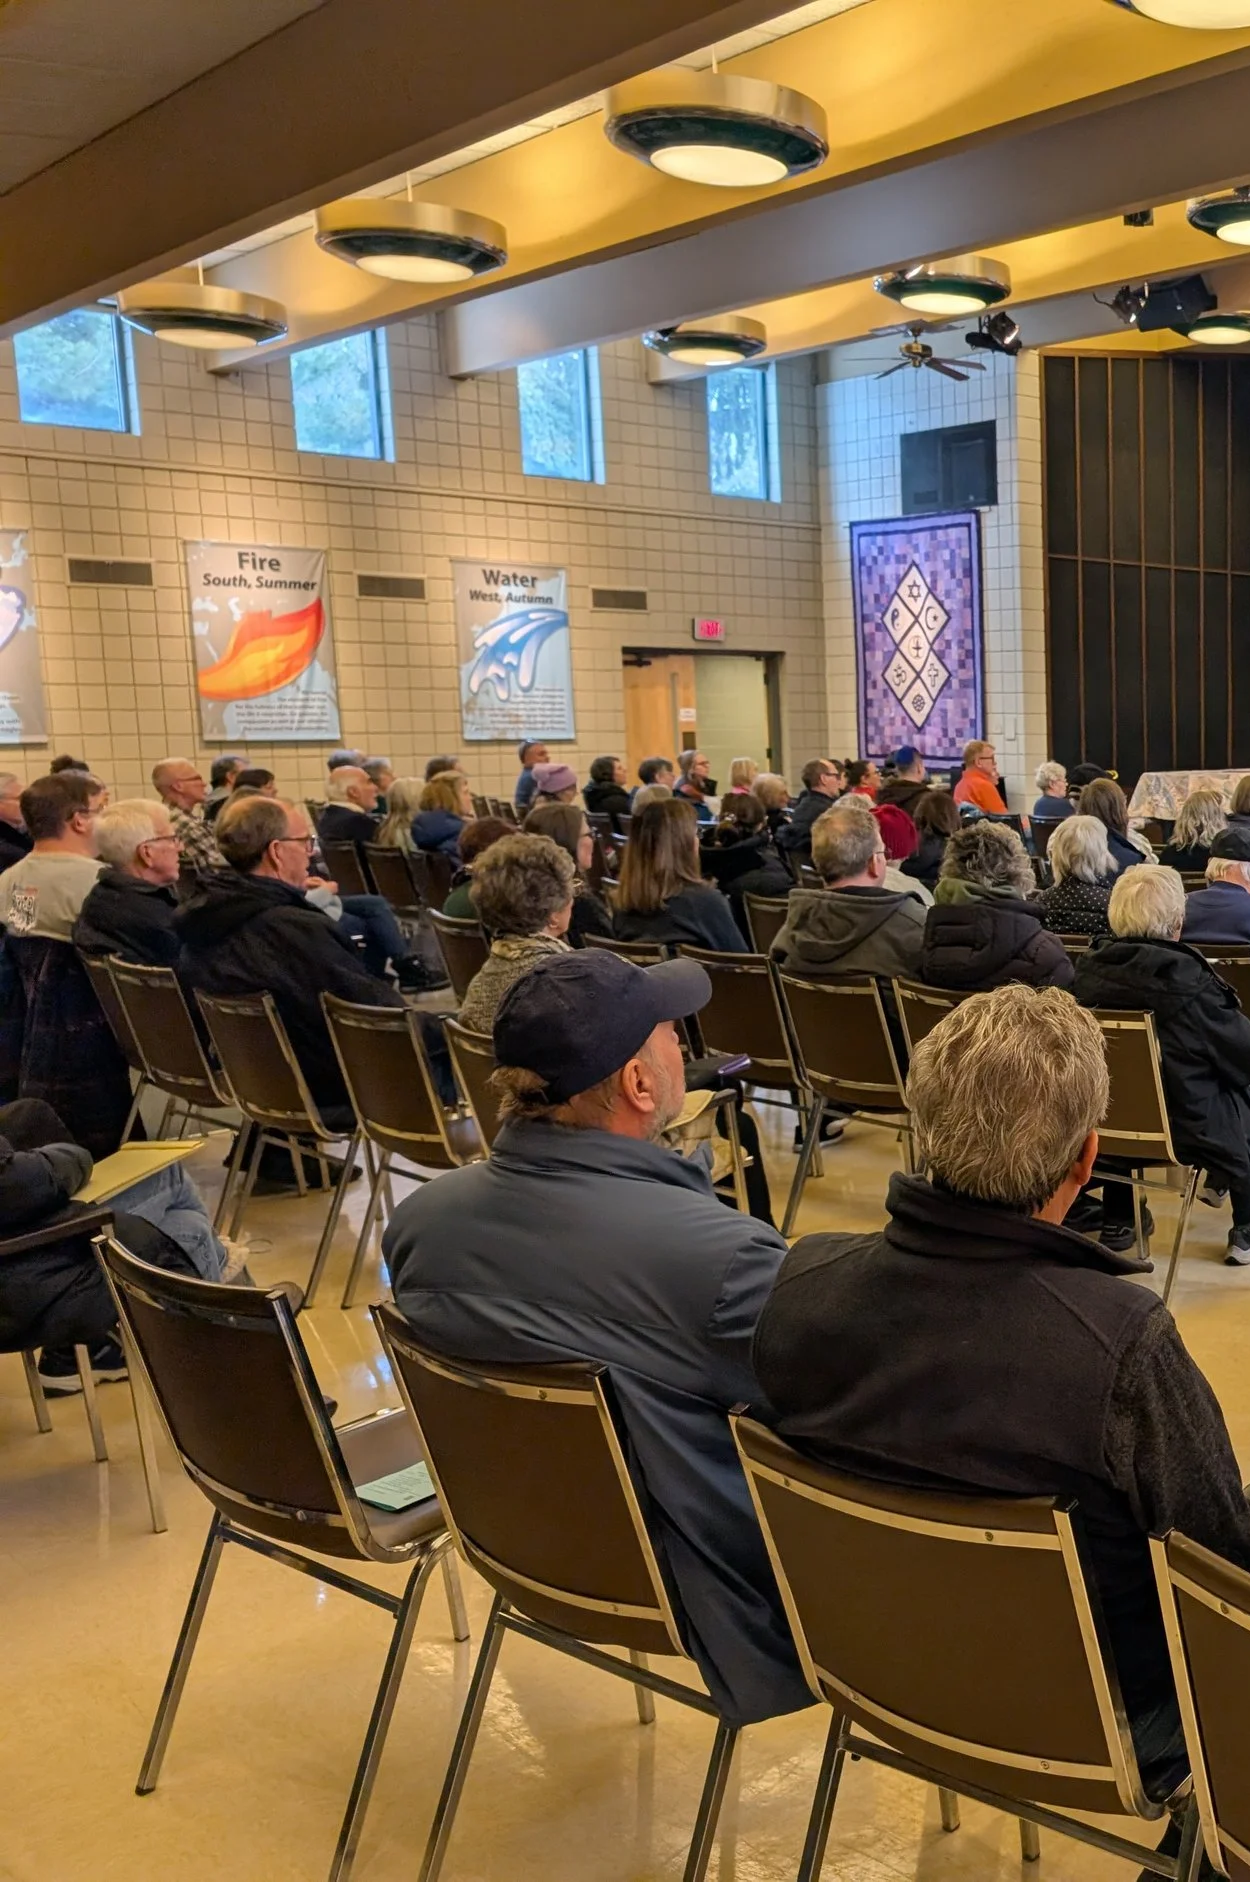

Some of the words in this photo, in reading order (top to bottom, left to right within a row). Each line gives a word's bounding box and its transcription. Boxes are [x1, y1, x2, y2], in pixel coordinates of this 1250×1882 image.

[237, 551, 282, 572] Fire
[202, 573, 252, 589] South,
[255, 576, 318, 591] Summer
[481, 568, 538, 588] Water
[469, 589, 502, 603] West,
[505, 592, 554, 605] Autumn
